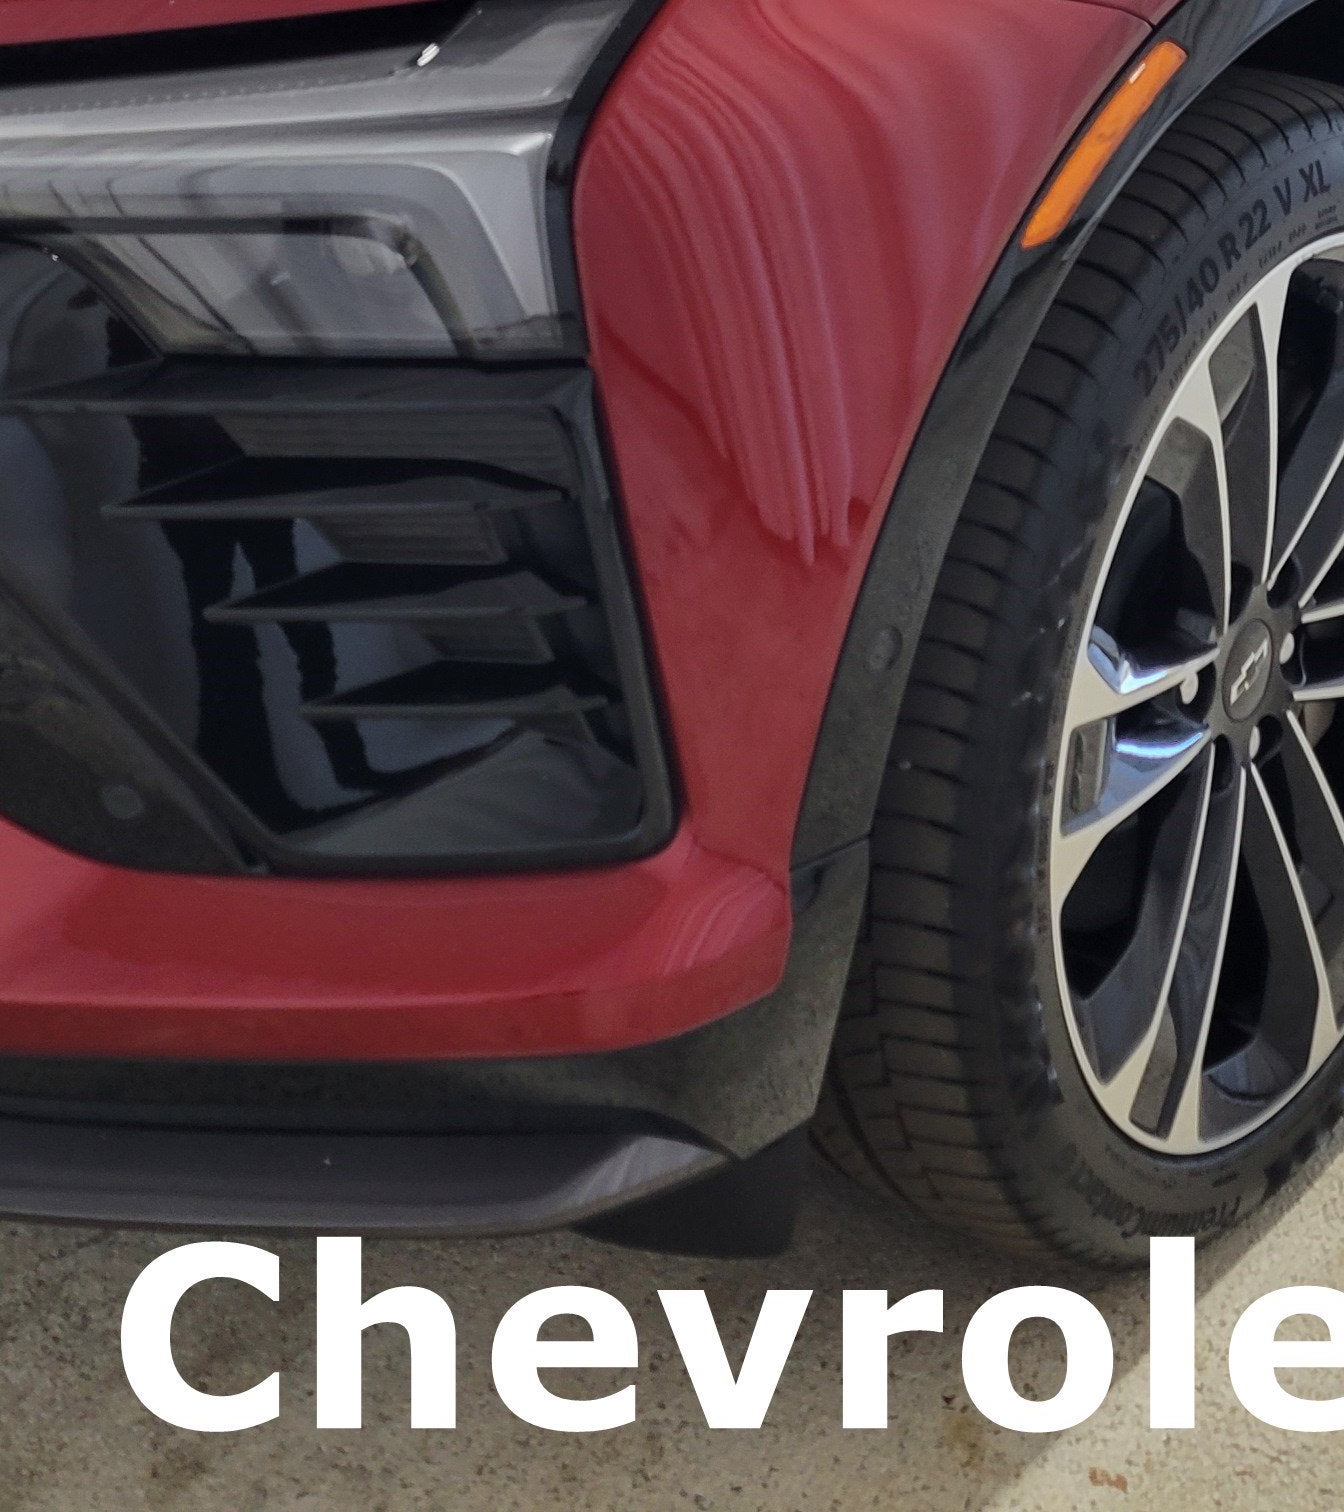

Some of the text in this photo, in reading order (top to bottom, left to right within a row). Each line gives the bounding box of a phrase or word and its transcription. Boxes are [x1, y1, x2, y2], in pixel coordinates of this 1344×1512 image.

[1133, 257, 1221, 397] 275/40
[1272, 176, 1293, 217] V
[1297, 158, 1331, 203] XL
